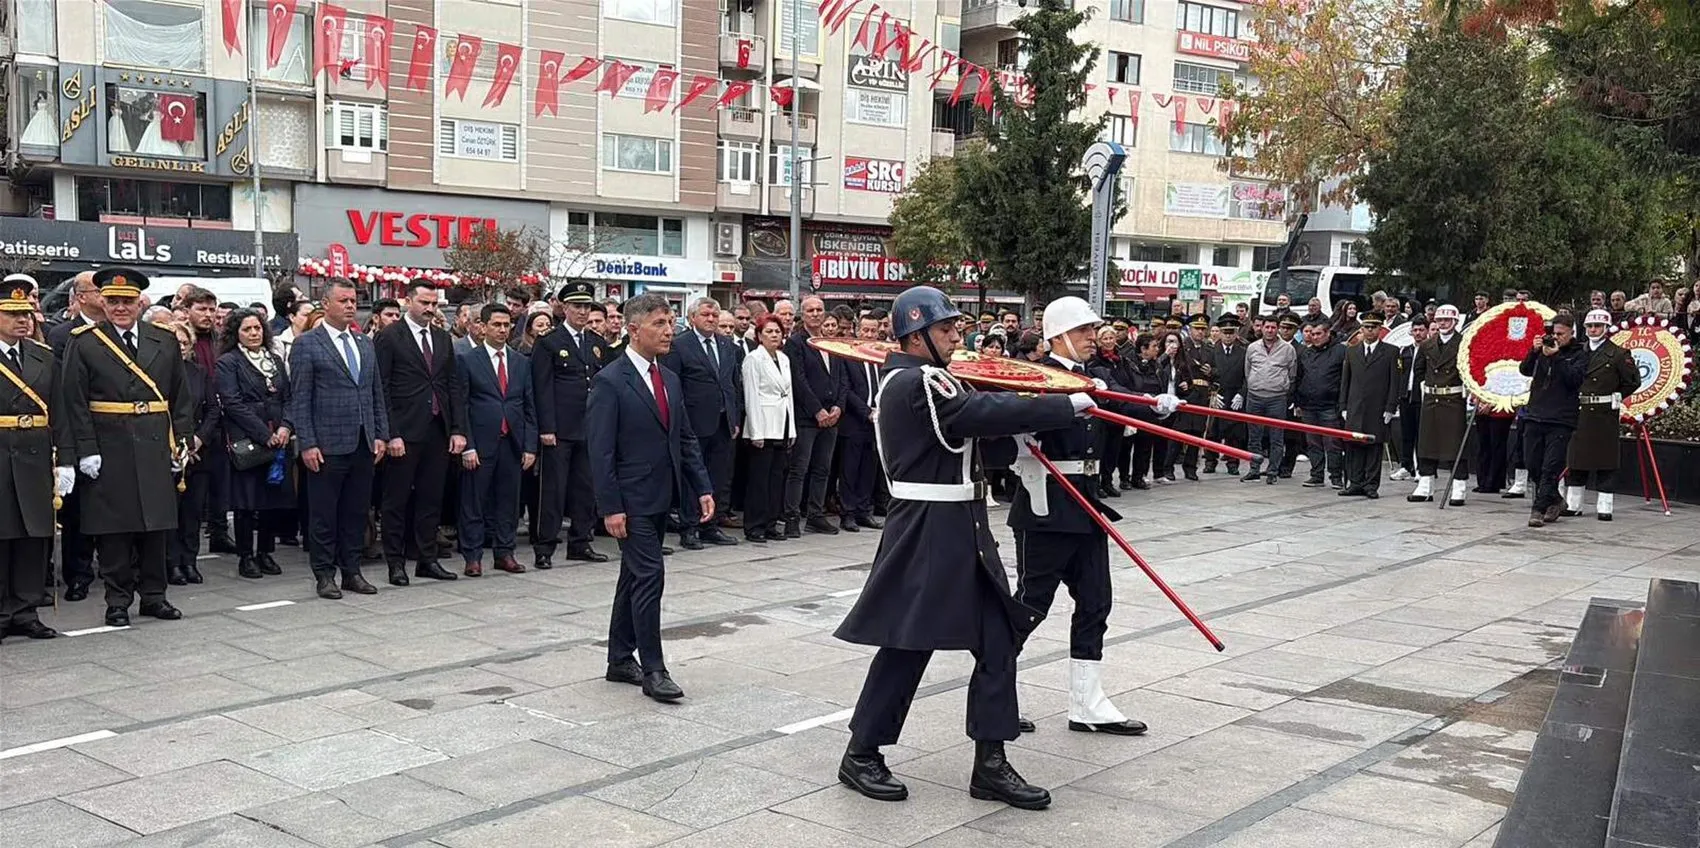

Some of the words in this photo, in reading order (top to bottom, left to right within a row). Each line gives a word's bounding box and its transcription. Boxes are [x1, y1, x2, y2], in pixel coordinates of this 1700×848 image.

[1194, 37, 1212, 51] NİL
[1214, 40, 1249, 57] PSİKOT
[62, 85, 97, 143] ASLI
[215, 101, 249, 156] ASLI
[867, 160, 903, 182] SRC
[867, 179, 902, 192] KURSU
[820, 237, 881, 253] İSKENDER
[197, 250, 281, 266] Restaurnt
[597, 260, 667, 277] DenizBank
[828, 256, 880, 280] BÜYÜK
[1162, 271, 1218, 286] LOTA
